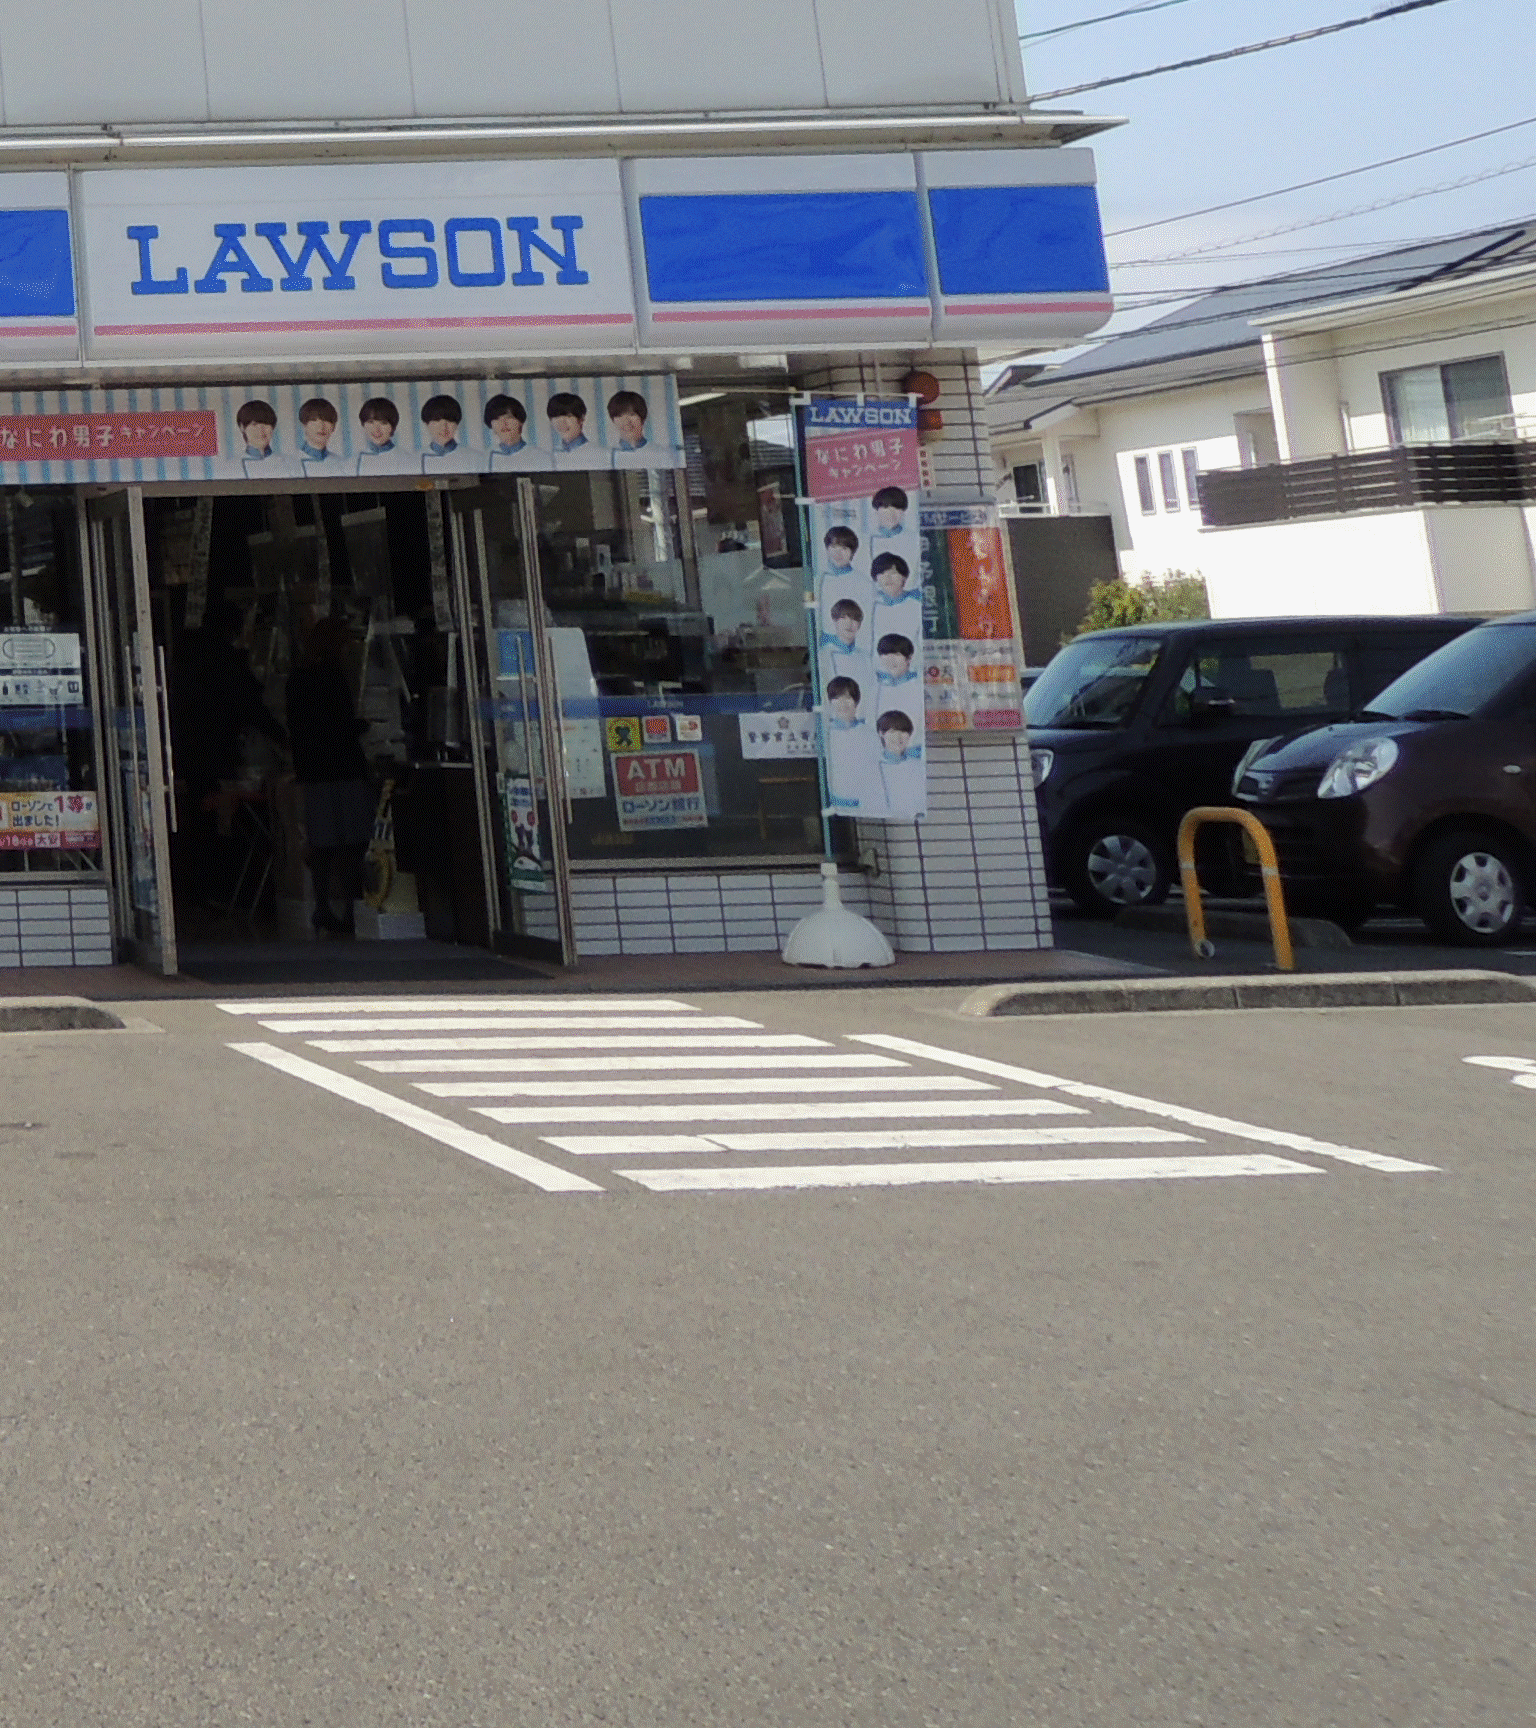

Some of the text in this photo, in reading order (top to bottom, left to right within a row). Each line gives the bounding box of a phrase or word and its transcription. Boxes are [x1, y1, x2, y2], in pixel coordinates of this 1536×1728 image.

[126, 214, 590, 295] LAWSON
[810, 406, 912, 425] LAWSON
[0, 423, 205, 450] なにわ男子 キャンペーン
[814, 437, 904, 465] なにわ男子
[627, 757, 686, 781] ATM
[622, 797, 700, 815] ローソン銀行
[12, 814, 59, 827] 出ました!
